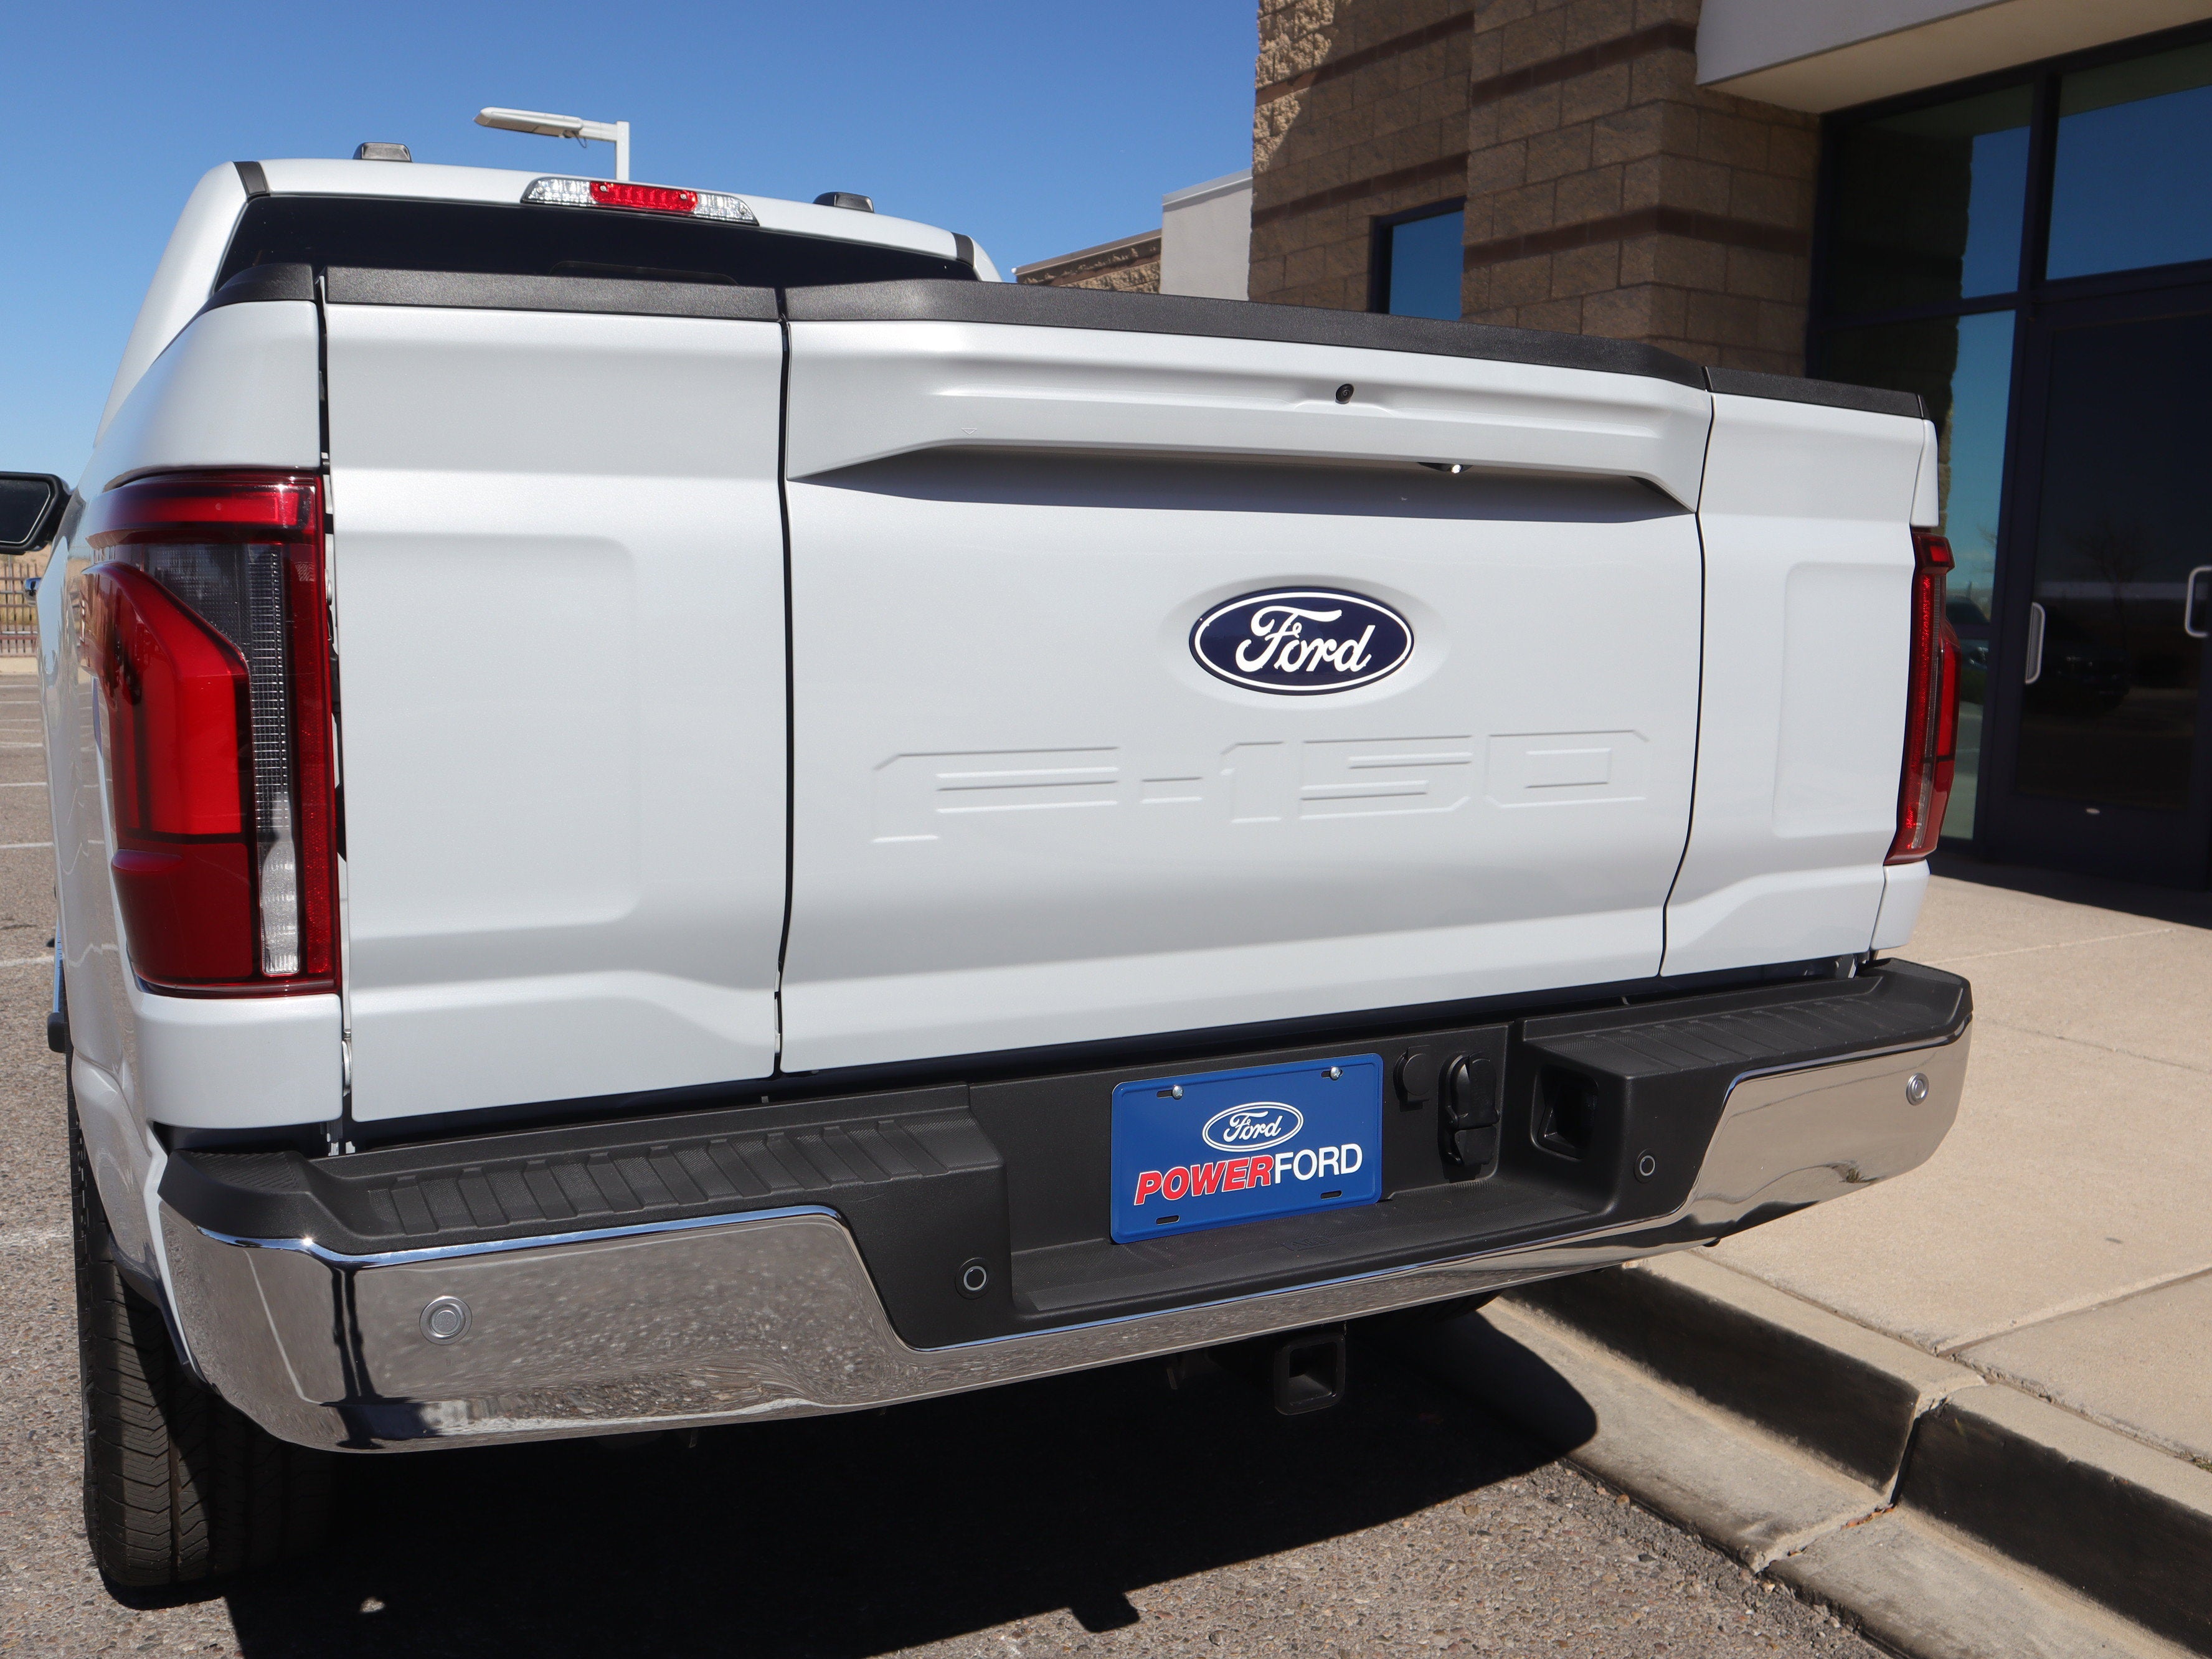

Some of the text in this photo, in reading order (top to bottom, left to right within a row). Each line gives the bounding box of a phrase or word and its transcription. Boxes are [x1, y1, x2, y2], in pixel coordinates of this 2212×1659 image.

[1234, 605, 1376, 673] Ford
[872, 729, 1649, 843] F-150
[1222, 1110, 1283, 1143] Ford
[1133, 1142, 1363, 1206] POWERFORD
